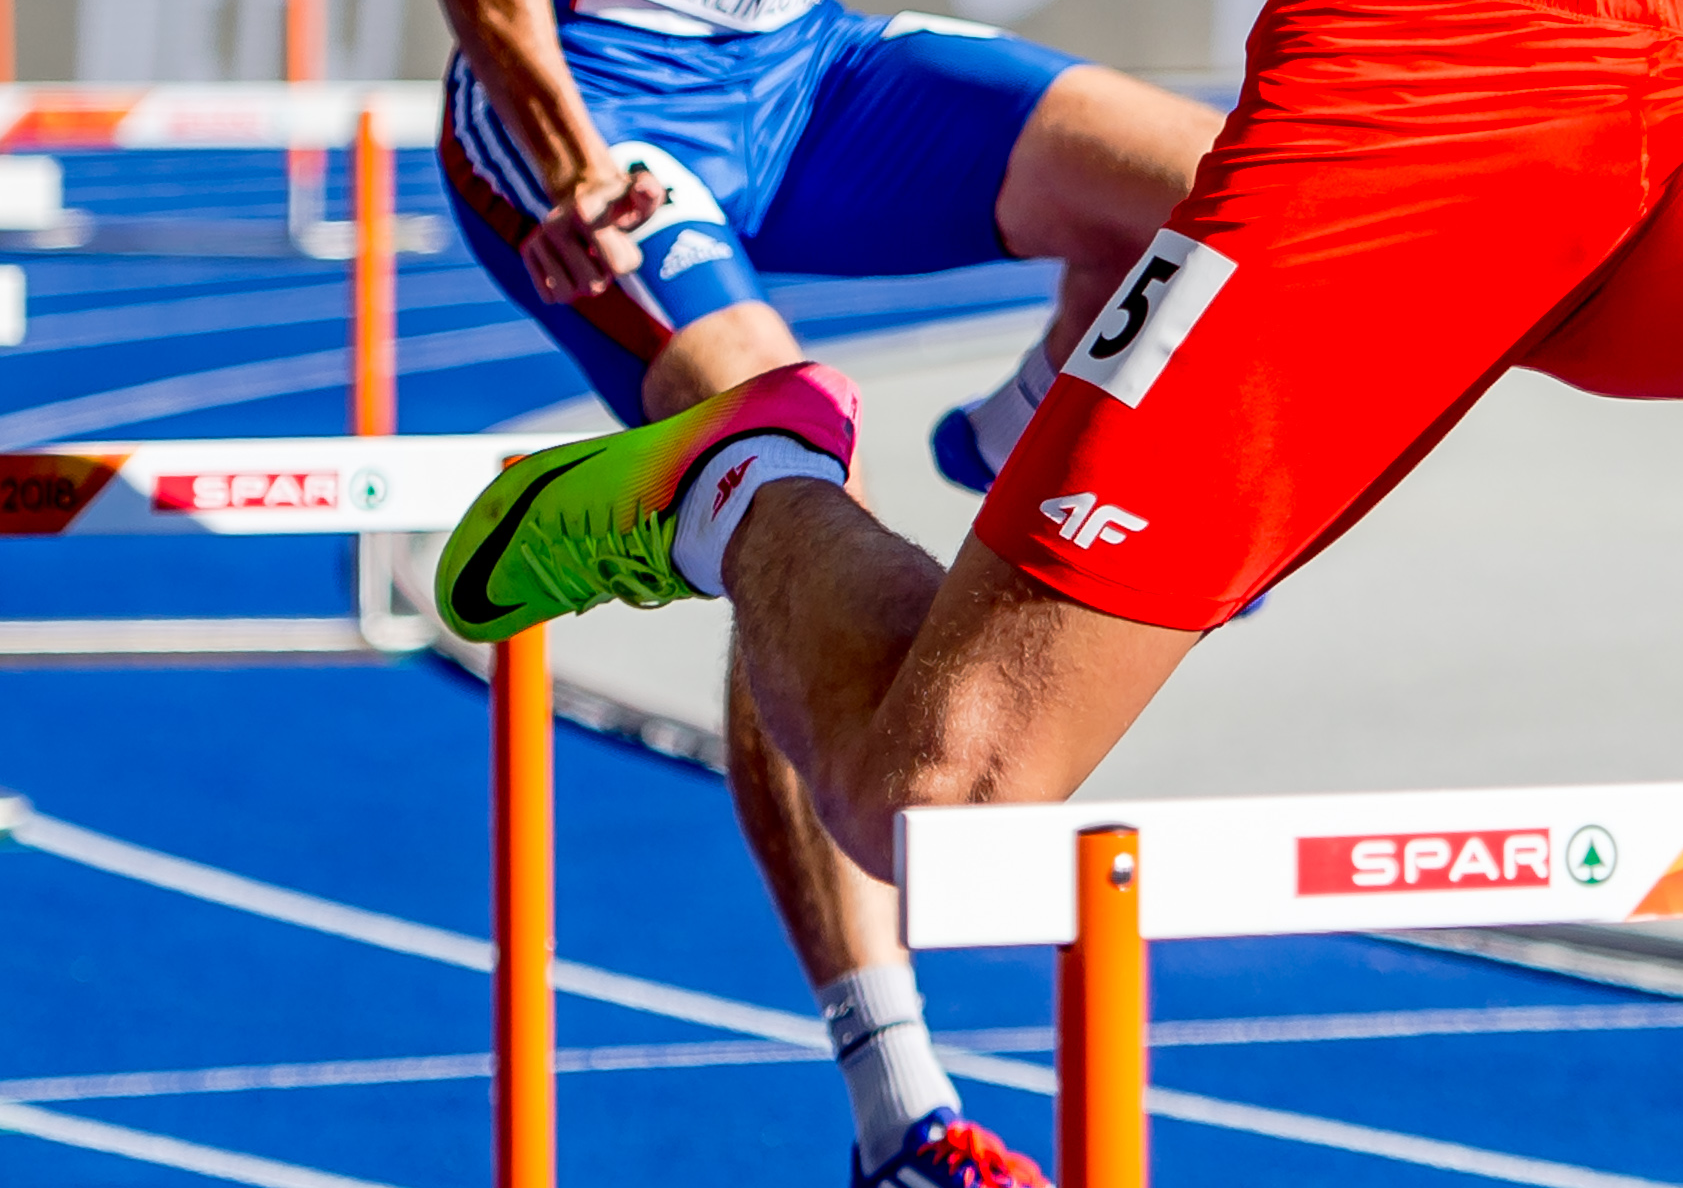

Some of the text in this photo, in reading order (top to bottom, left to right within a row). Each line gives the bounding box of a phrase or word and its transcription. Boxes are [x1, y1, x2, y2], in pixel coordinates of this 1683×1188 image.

[1088, 255, 1181, 360] 5
[1, 477, 76, 510] 2018
[193, 475, 337, 508] SPAR
[1351, 833, 1549, 887] SPAR
